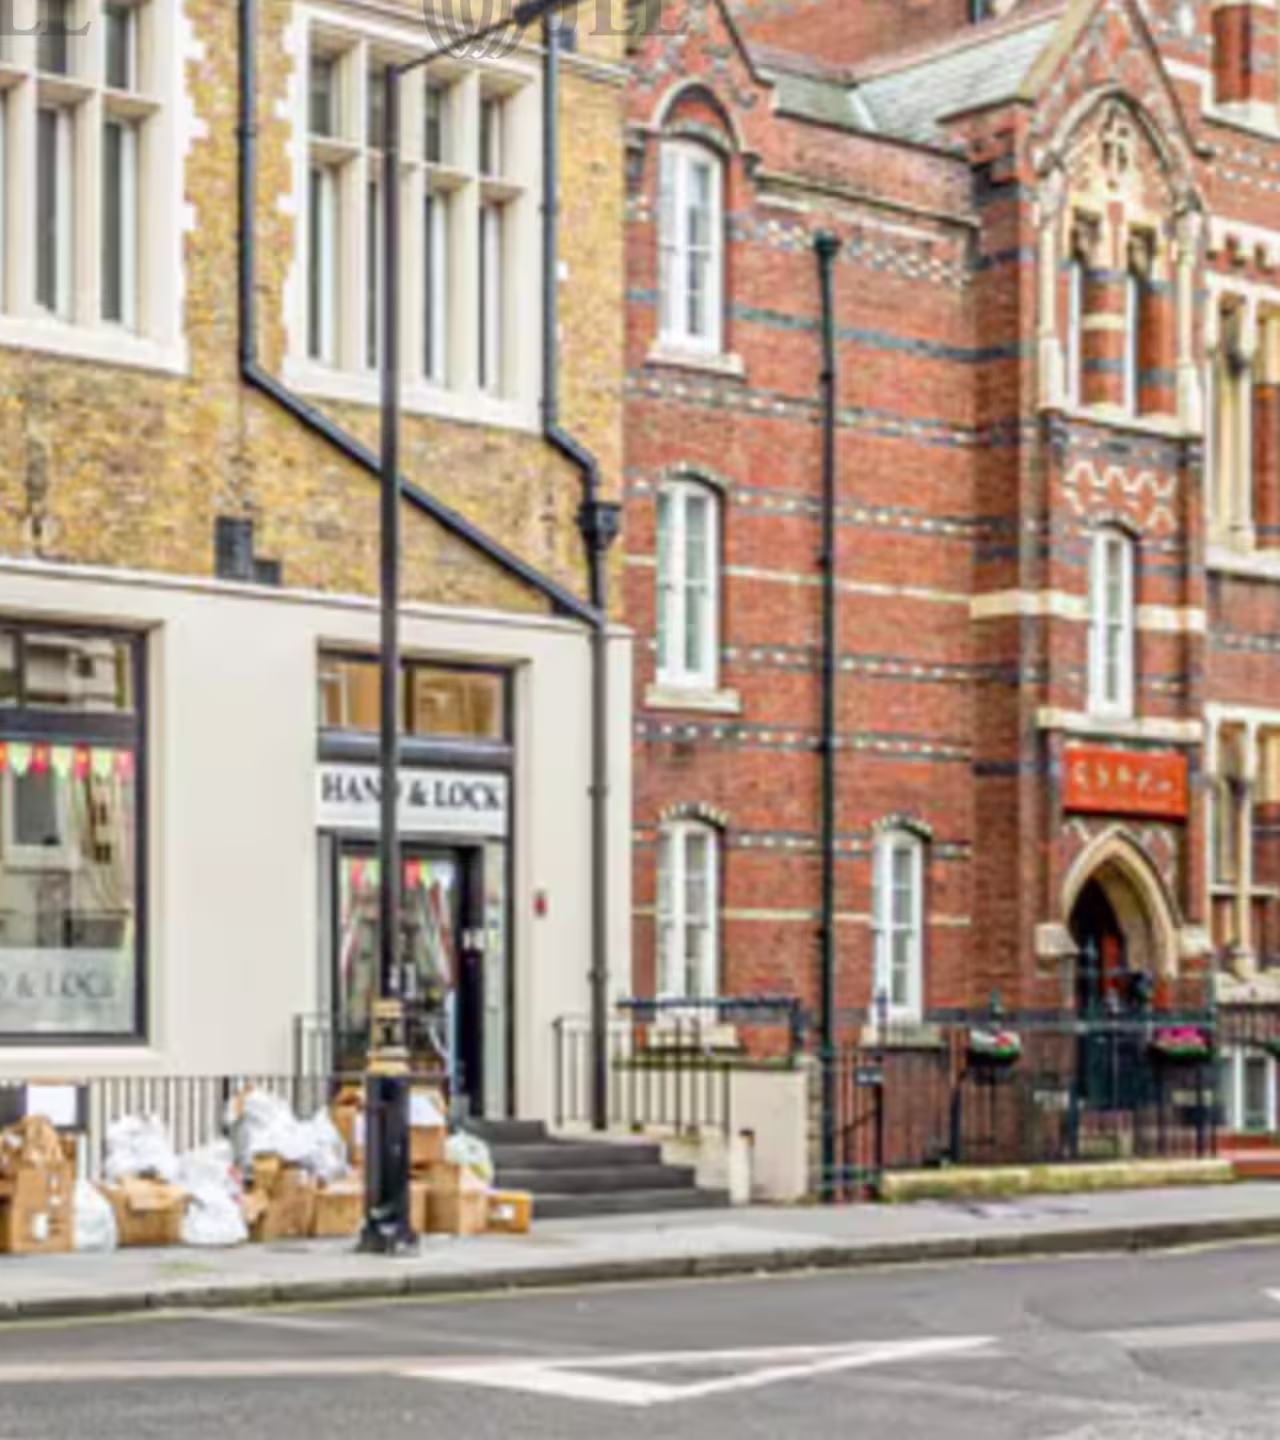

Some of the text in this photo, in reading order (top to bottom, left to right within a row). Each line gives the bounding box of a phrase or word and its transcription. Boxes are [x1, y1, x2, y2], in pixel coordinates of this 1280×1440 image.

[322, 772, 502, 812] HAN & LOCK
